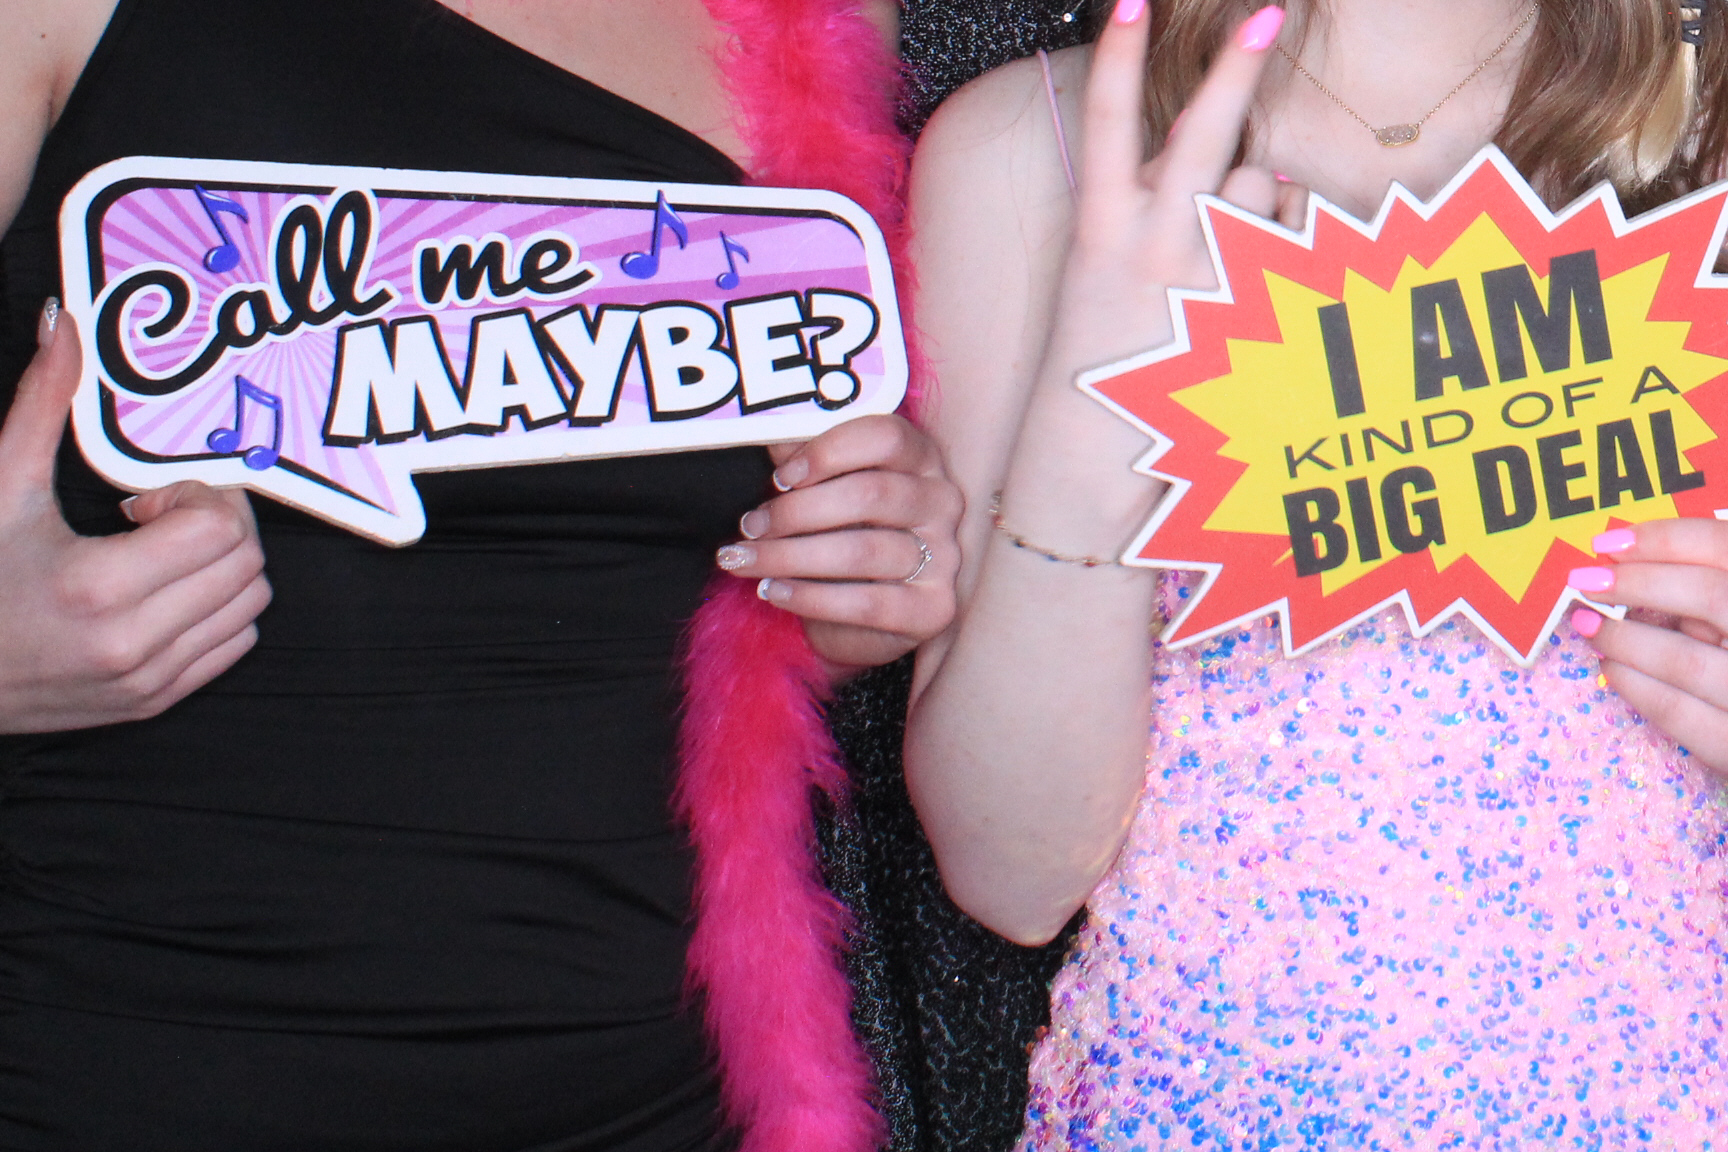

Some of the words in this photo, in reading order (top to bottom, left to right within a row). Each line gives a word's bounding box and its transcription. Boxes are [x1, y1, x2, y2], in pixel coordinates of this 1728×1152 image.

[95, 190, 393, 395] Call
[420, 239, 593, 303] me
[323, 291, 878, 448] MAYBE?
[1317, 302, 1366, 418] I
[1410, 250, 1613, 401] AM
[1282, 466, 1447, 578] BIG
[1473, 410, 1704, 535] DEAL
[1284, 410, 1474, 478] KIND
[1501, 377, 1603, 428] OF
[1631, 365, 1681, 402] A
